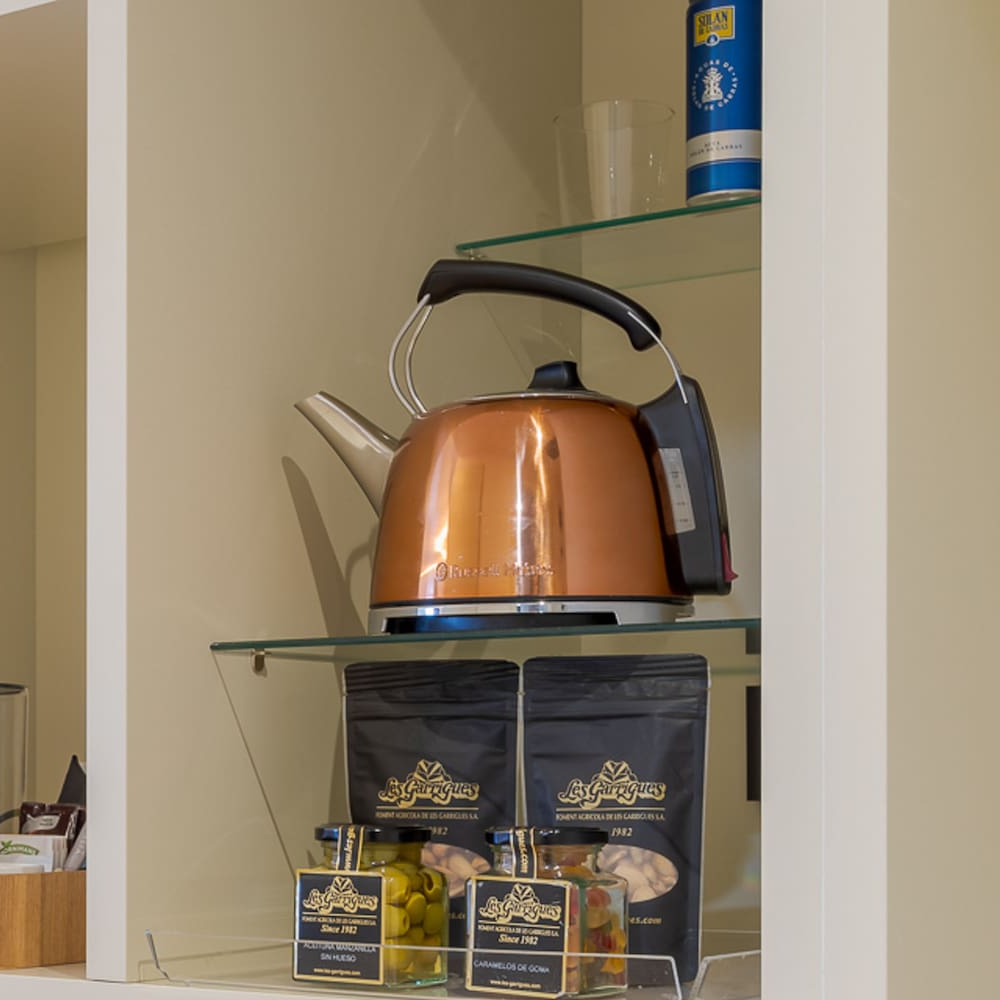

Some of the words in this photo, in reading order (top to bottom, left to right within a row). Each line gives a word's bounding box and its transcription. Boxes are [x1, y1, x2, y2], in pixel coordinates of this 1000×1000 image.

[497, 933, 520, 944] Since
[520, 935, 539, 946] 1982
[320, 953, 331, 961] SIN
[332, 954, 357, 962] HUESO
[473, 960, 516, 971] CARAMELOS
[517, 964, 527, 972] DE
[528, 965, 550, 973] GOMA
